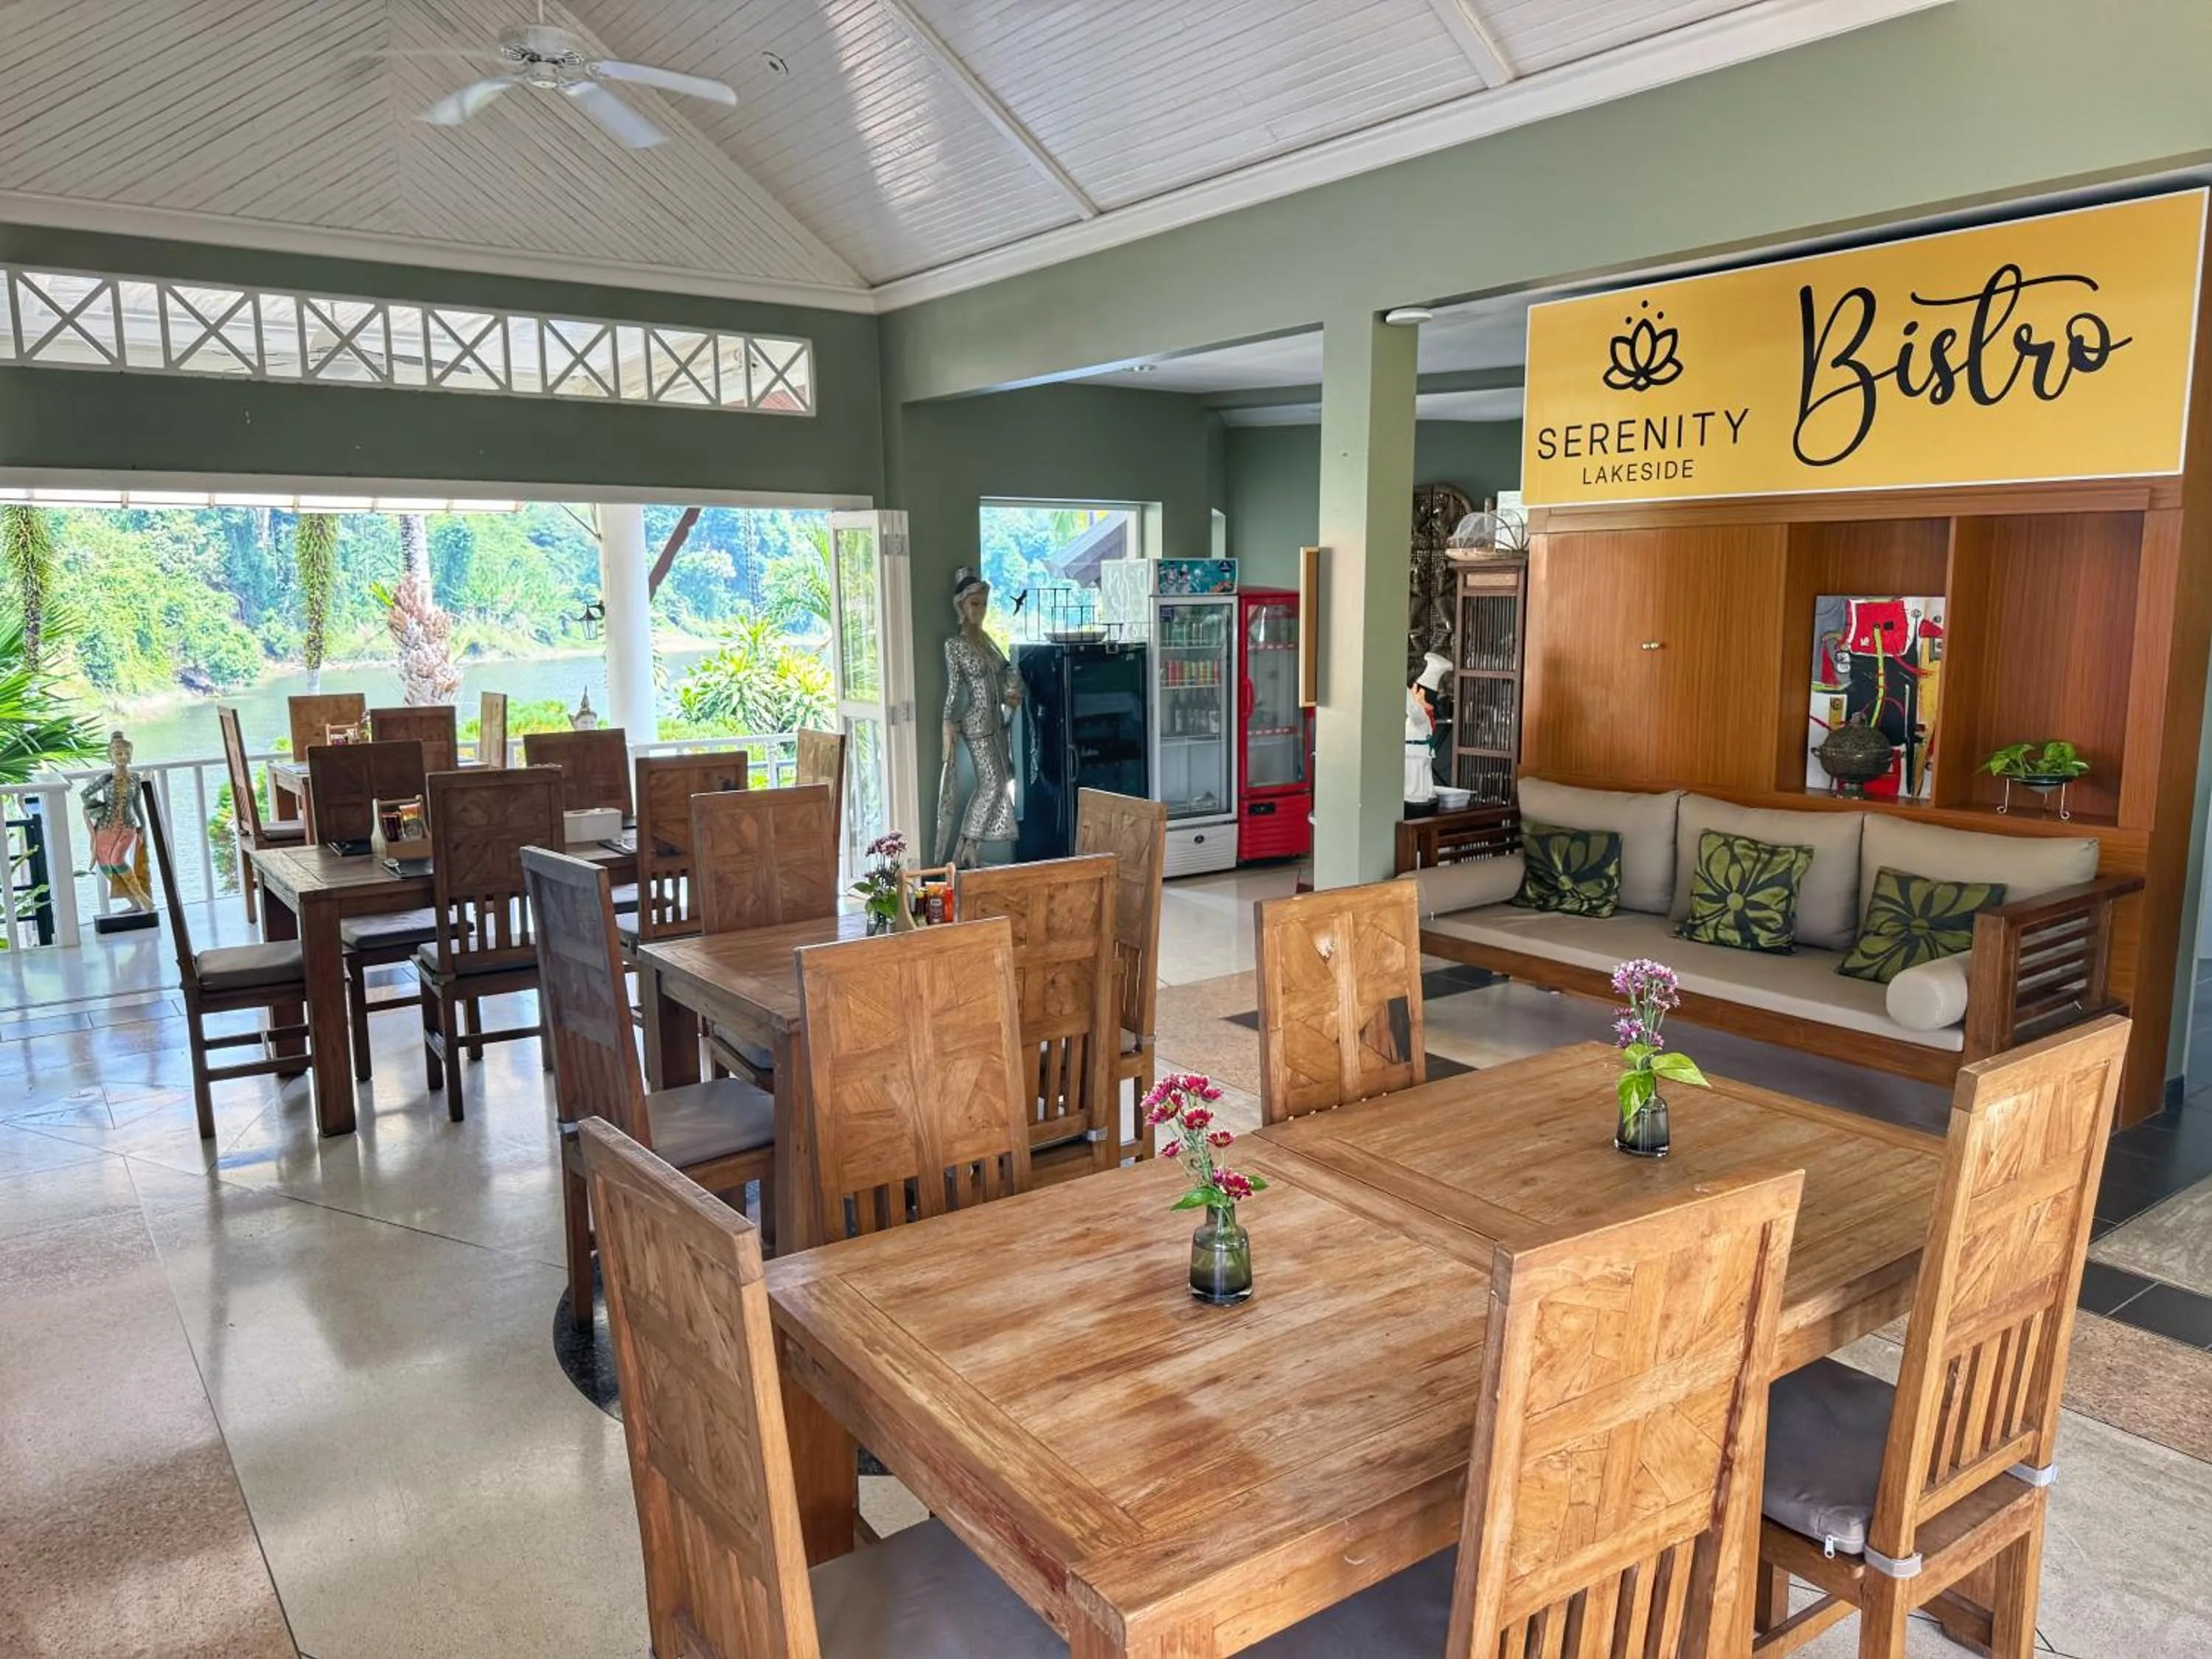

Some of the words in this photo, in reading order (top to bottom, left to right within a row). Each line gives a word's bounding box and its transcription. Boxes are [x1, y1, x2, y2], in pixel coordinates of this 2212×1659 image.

[1792, 263, 2133, 467] Bistro
[1537, 408, 1749, 460] SERENITY
[1582, 459, 1694, 484] LAKESIDE
